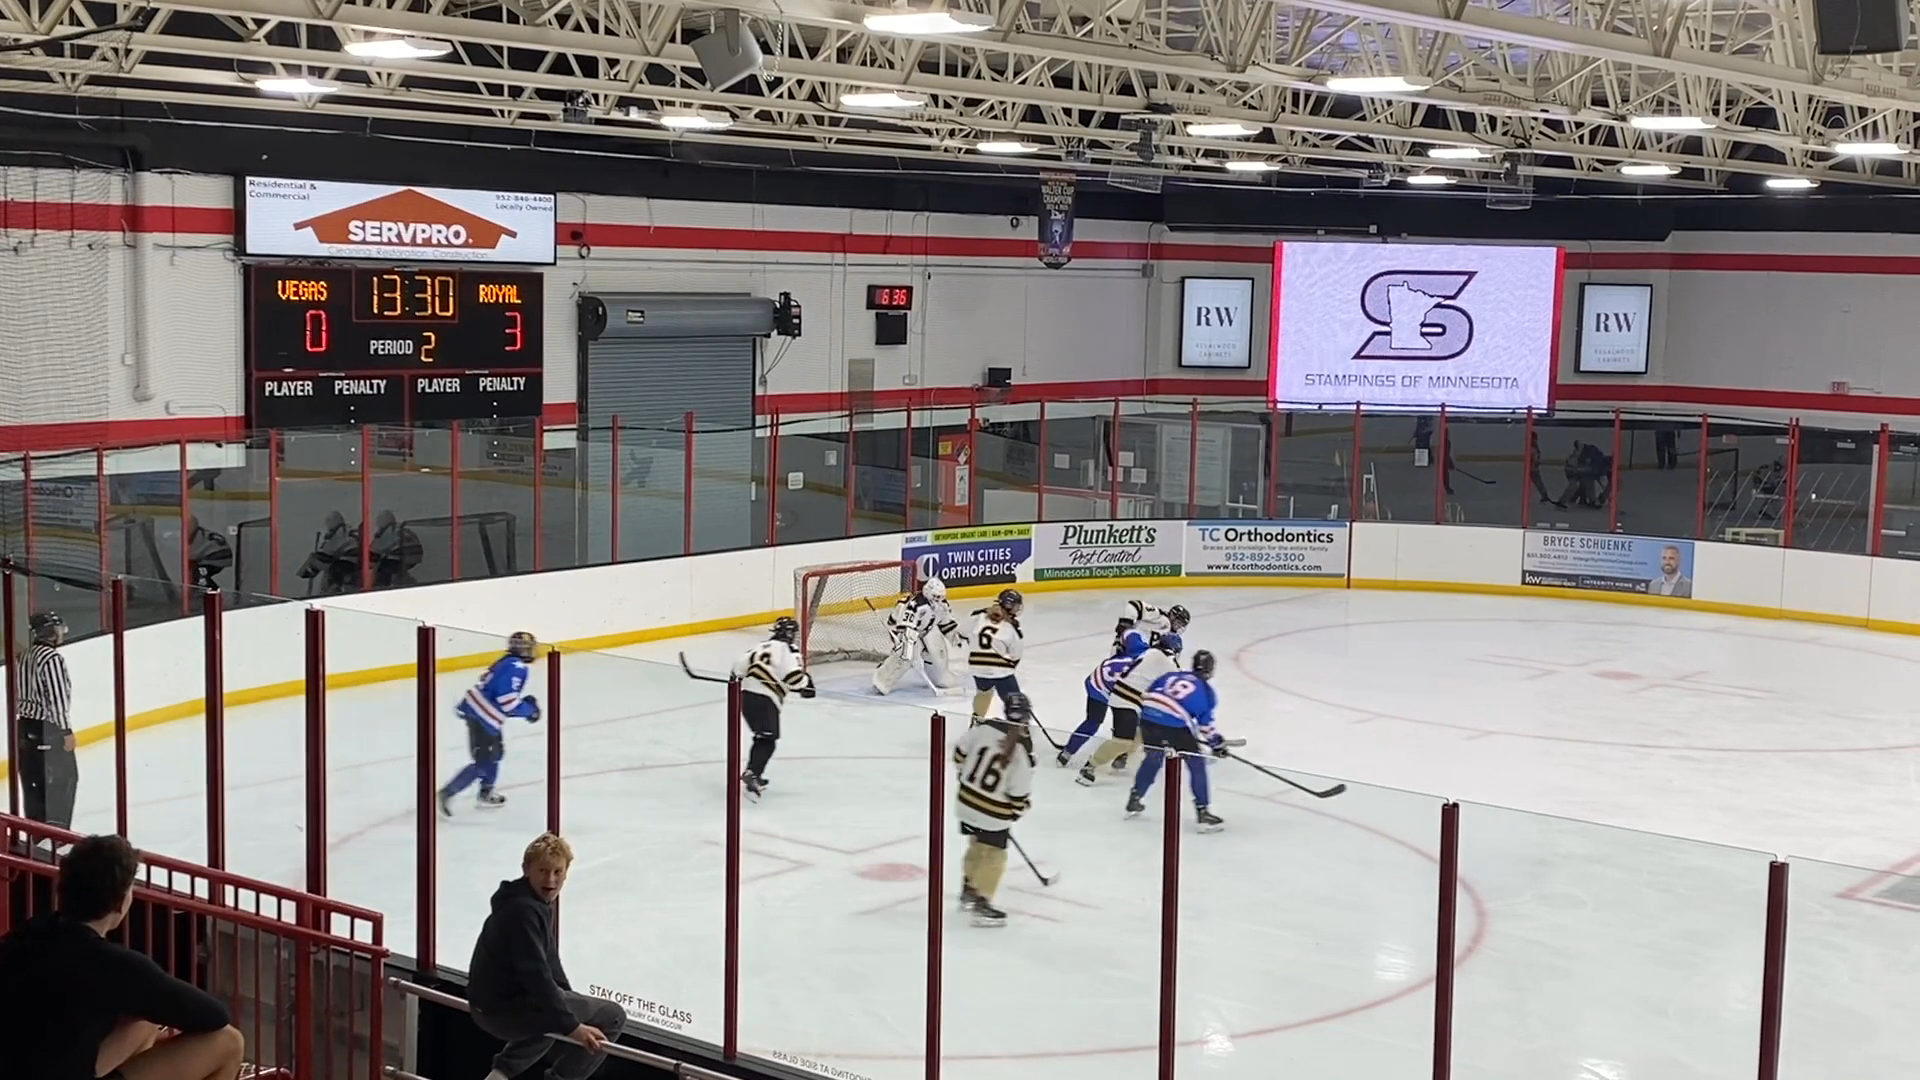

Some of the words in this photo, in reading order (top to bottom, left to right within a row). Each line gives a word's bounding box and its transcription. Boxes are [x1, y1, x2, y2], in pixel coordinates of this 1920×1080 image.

[248, 180, 307, 190] Residential
[248, 190, 310, 200] Commercial
[495, 203, 523, 211] Locally
[525, 204, 553, 212] Owned
[277, 279, 328, 301] VEGAS
[372, 274, 454, 317] 13:30
[478, 283, 522, 304] ROYAL
[1196, 306, 1238, 328] RW
[1595, 312, 1637, 333] RW
[305, 309, 327, 352] 0
[503, 311, 521, 351] 3
[369, 339, 414, 355] PERIOD
[421, 331, 436, 362] 2
[264, 381, 314, 396] PLAYER
[334, 379, 387, 395] PENALTY
[417, 378, 461, 393] PLAYER
[479, 376, 526, 392] PENALTY
[1304, 373, 1396, 388] STAMPINGS
[1401, 375, 1423, 388] OF
[1428, 376, 1520, 389] MINNESOTA
[1060, 524, 1157, 546] Plunkett's
[1198, 527, 1221, 542] TC
[1224, 527, 1334, 544] Orthodontics
[1543, 535, 1576, 548] BRYCE
[1580, 537, 1634, 552] SCHUENKE
[947, 551, 975, 564] TWIN
[977, 547, 1012, 562] CITIES
[1097, 546, 1142, 564] Control
[1224, 552, 1306, 563] 952-892-5300
[941, 562, 1017, 580] ORTHOPEDICS
[1043, 567, 1090, 578] Minnesota
[1092, 567, 1119, 578] Tough
[1121, 565, 1146, 576] Since
[1149, 565, 1171, 575] 1915
[1206, 563, 1322, 572] www.tcorthodontics.com
[1525, 573, 1542, 584] kw
[978, 625, 999, 649] 6
[966, 746, 1002, 793] 16
[589, 984, 613, 999] STAY
[615, 992, 634, 1006] OFF
[637, 998, 656, 1013] THE
[658, 1005, 693, 1024] GLASS
[625, 1009, 647, 1019] NJURY
[647, 1014, 660, 1024] CAN
